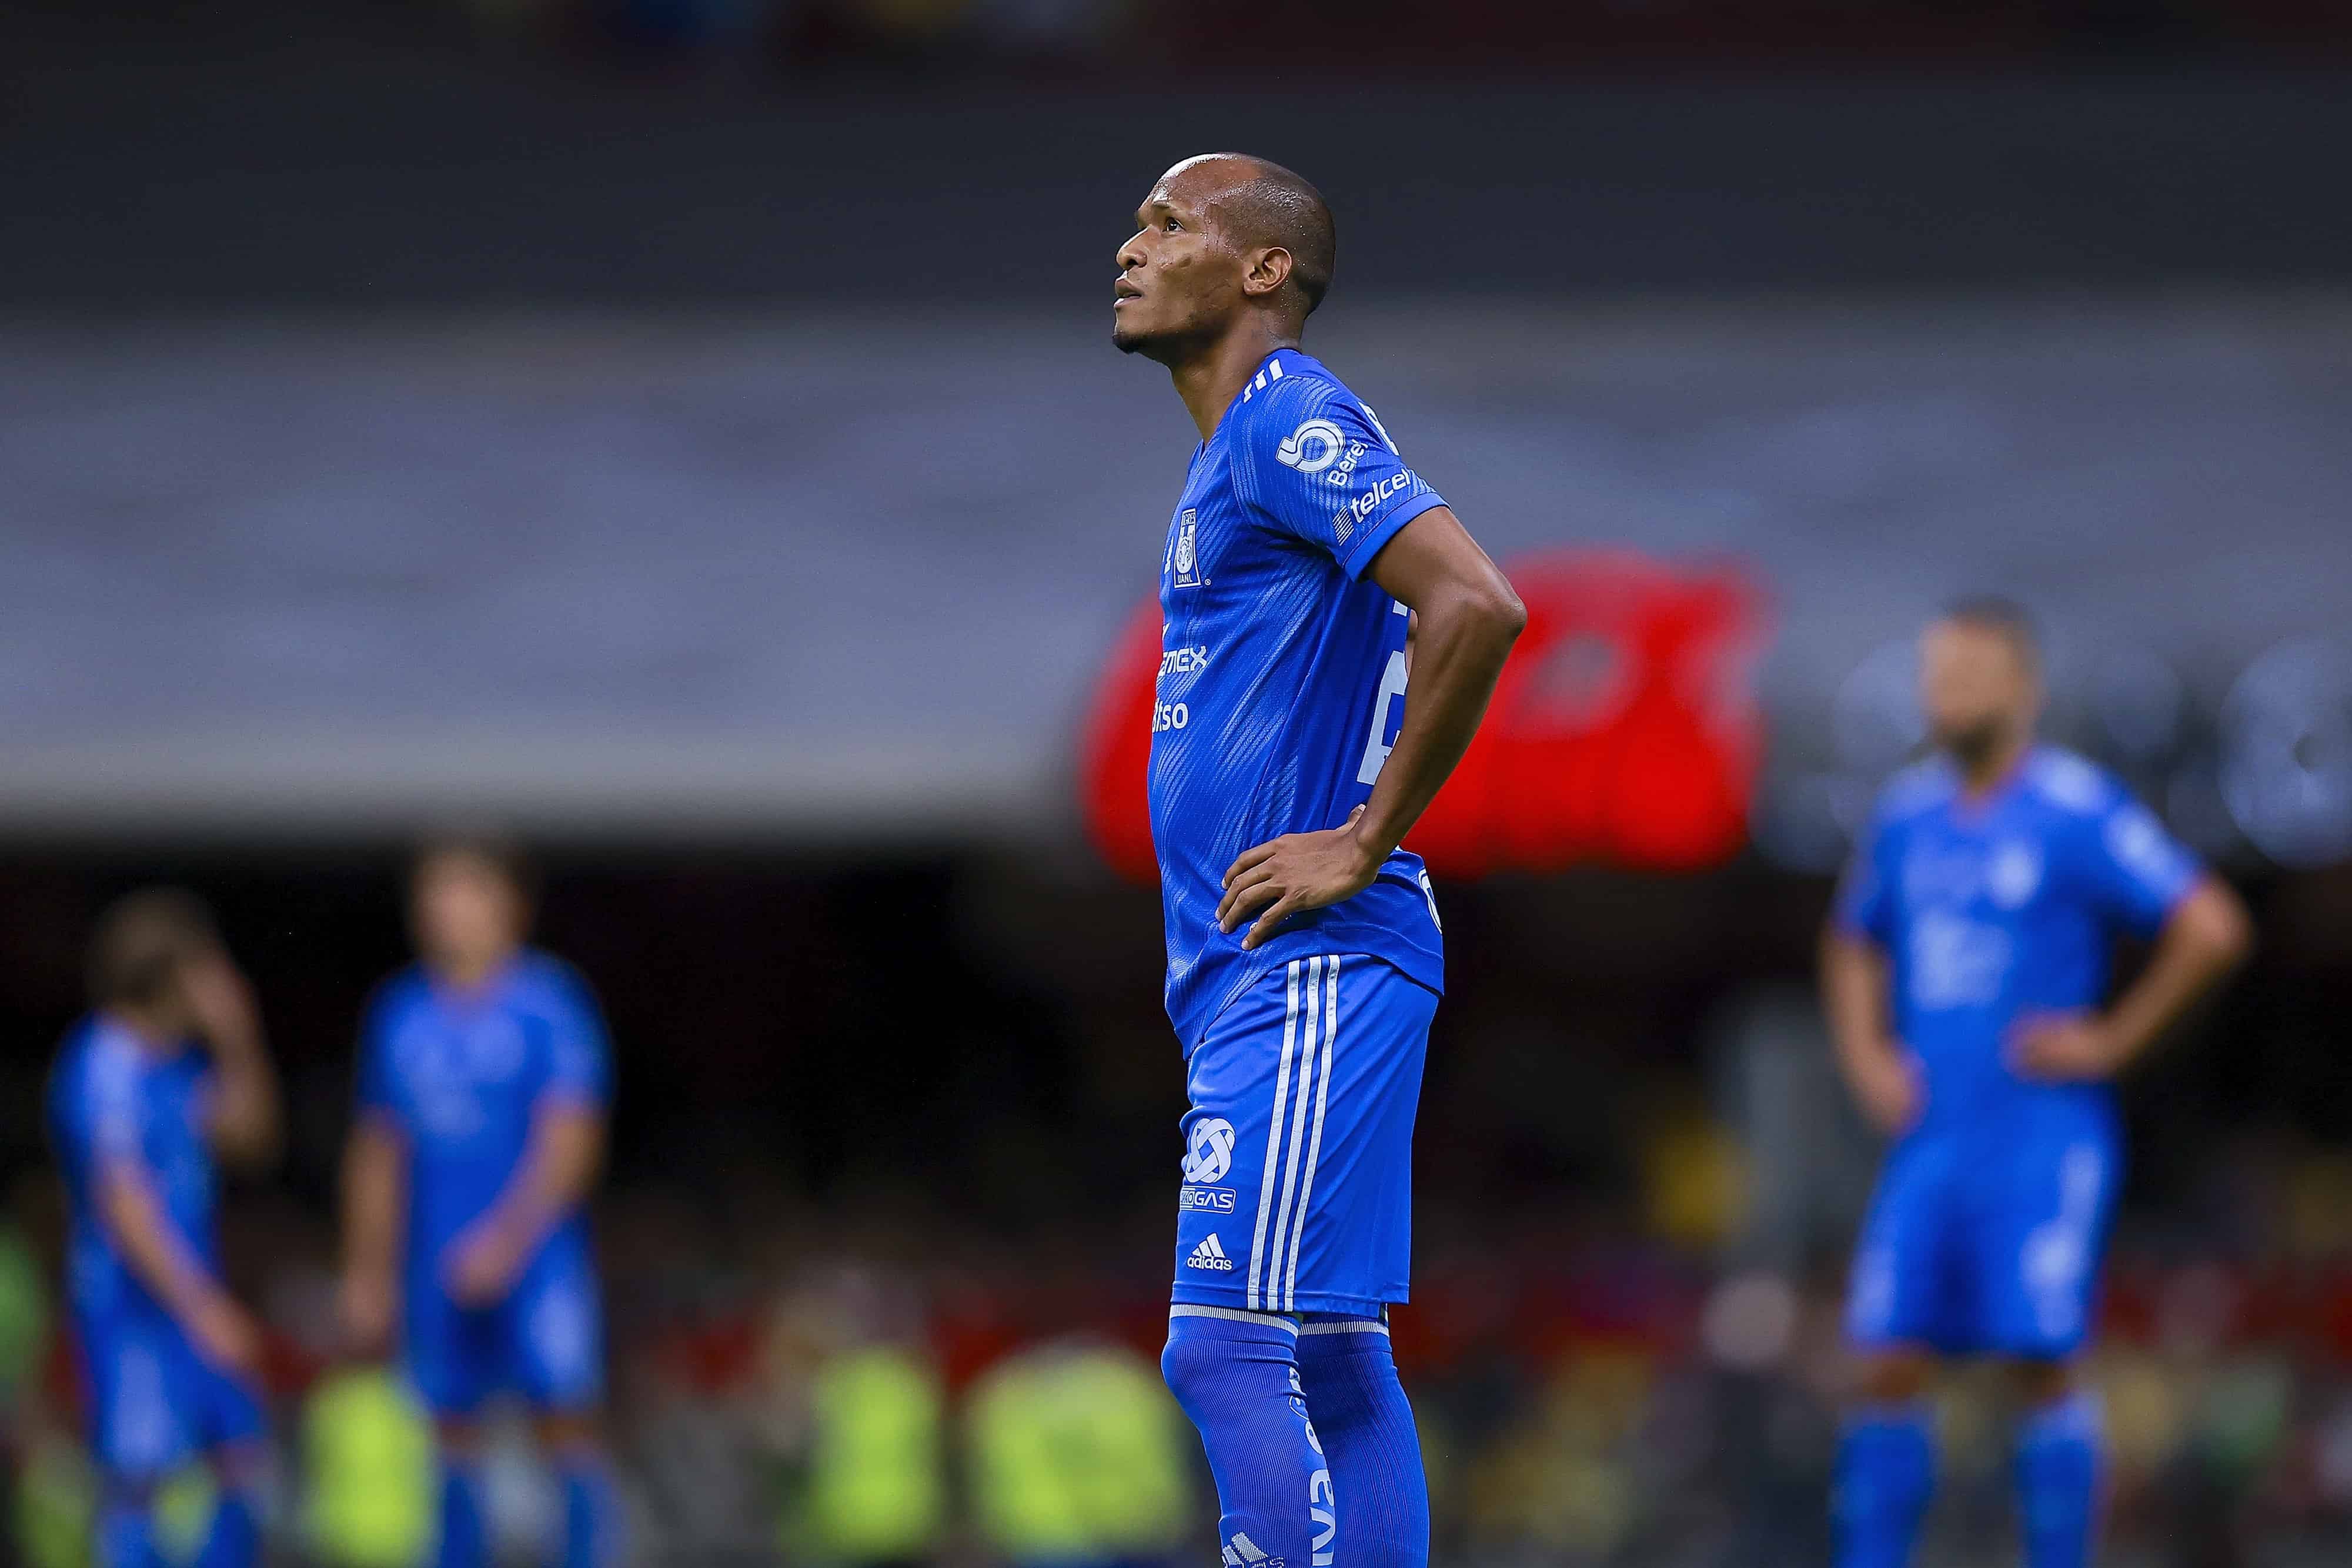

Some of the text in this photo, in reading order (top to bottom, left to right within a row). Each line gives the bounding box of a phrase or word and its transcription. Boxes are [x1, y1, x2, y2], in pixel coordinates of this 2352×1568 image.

[1350, 468, 1411, 523] telcel
[1177, 573, 1193, 584] UANL
[1157, 645, 1207, 677] EMEX
[1187, 1256, 1232, 1271] adidas
